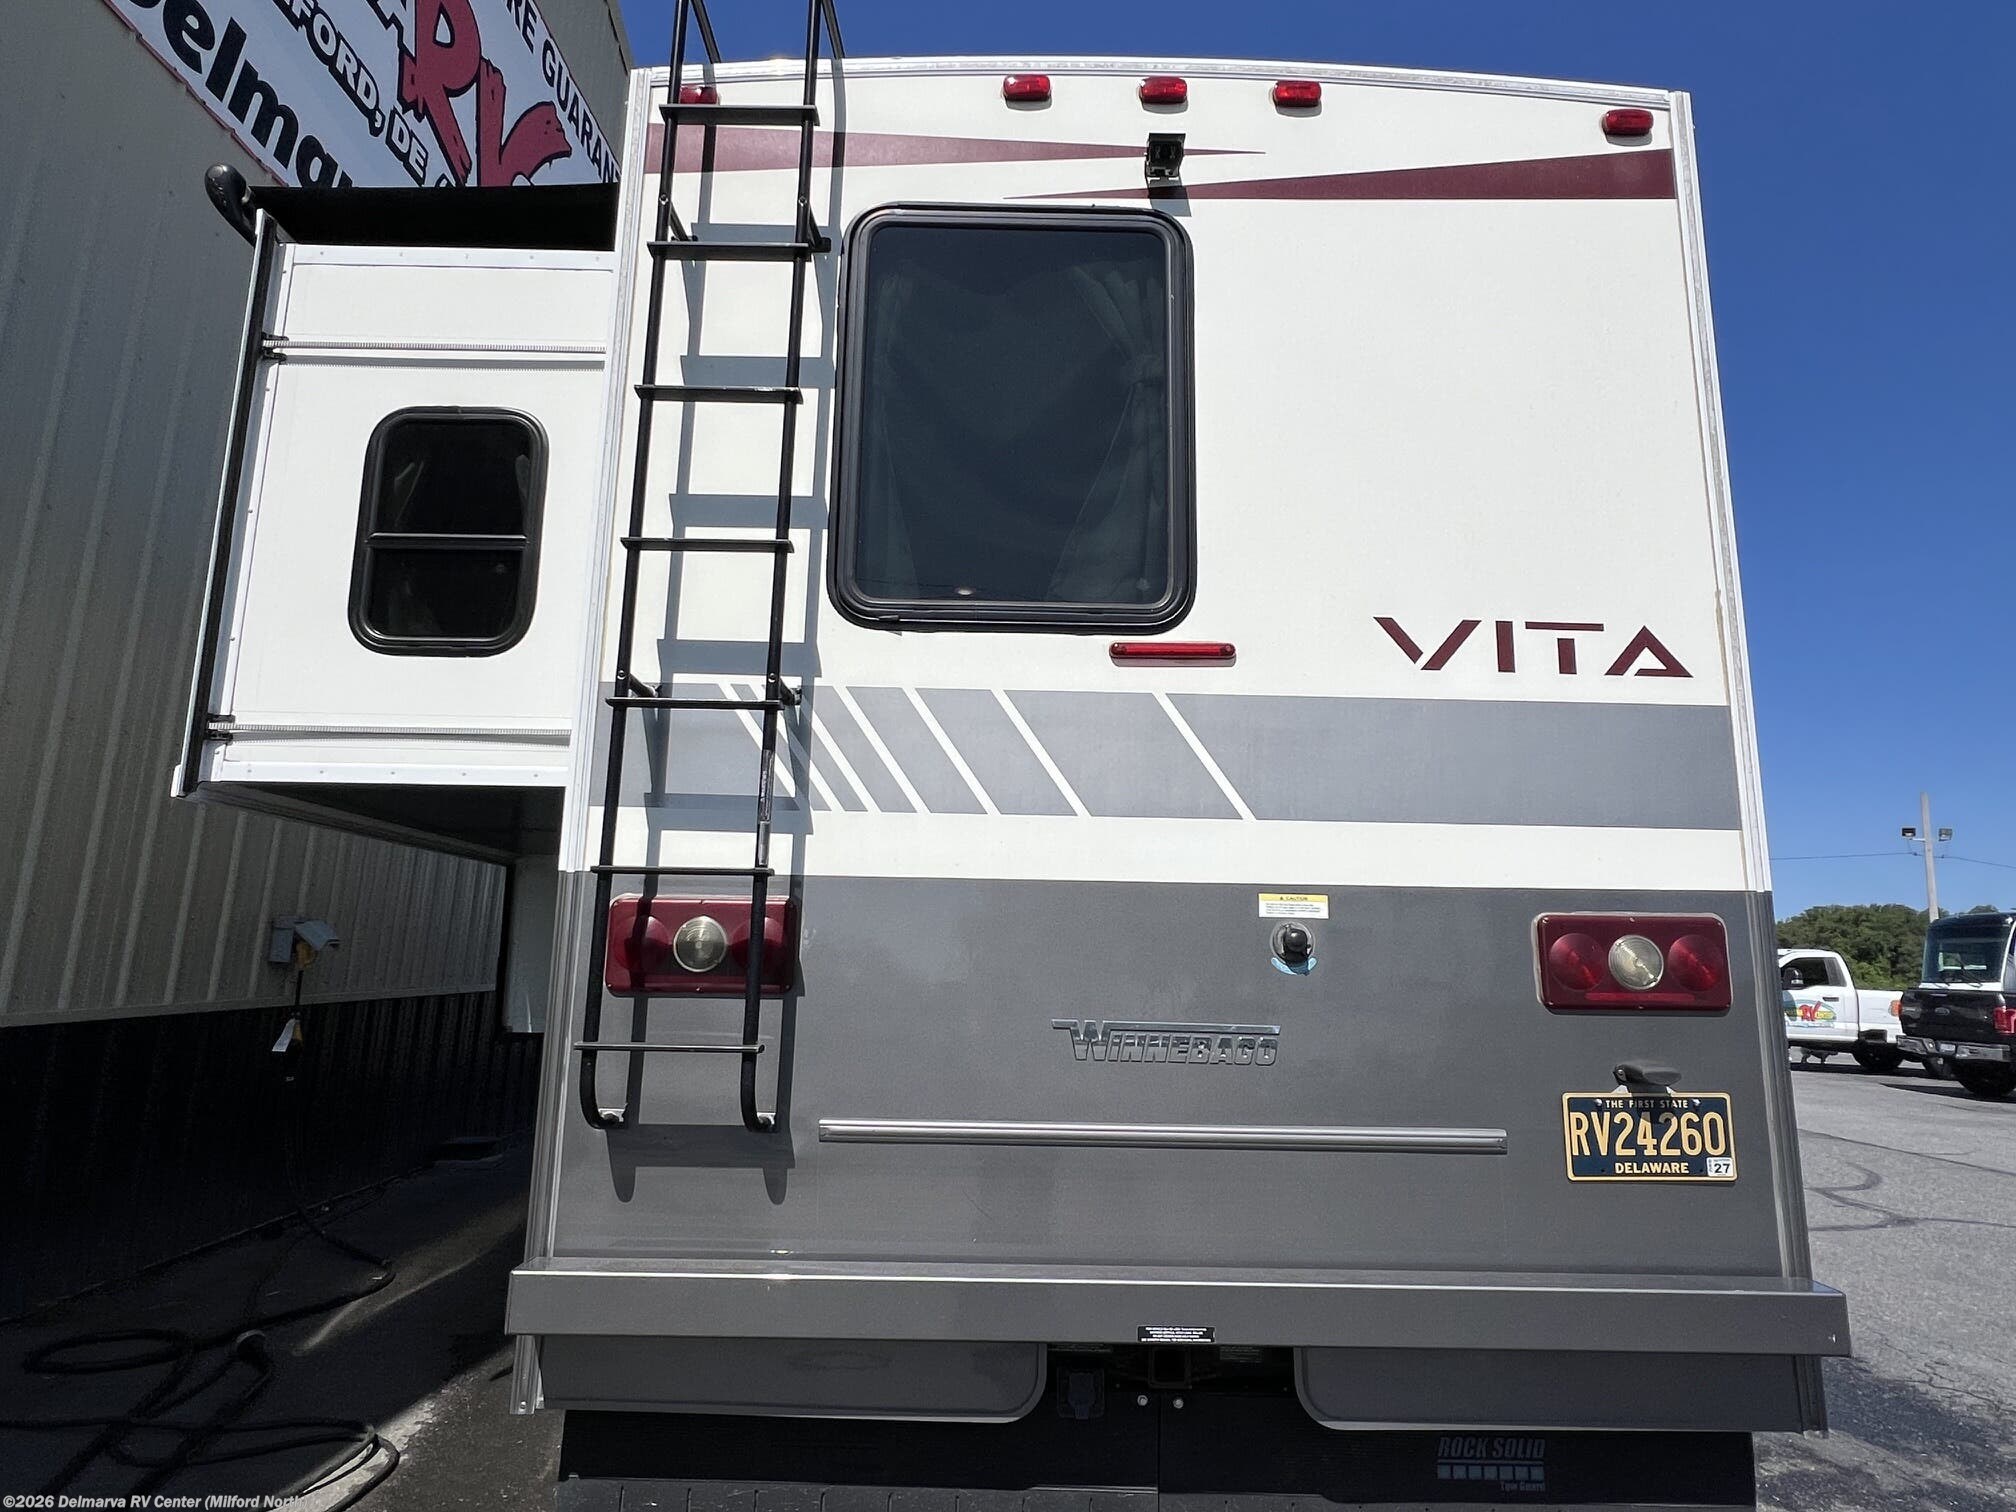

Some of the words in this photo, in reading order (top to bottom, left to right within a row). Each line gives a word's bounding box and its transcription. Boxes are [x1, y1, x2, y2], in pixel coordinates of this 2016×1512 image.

[542, 39, 620, 183] GUARAN
[388, 109, 428, 182] DE
[1373, 616, 1694, 678] VITA
[1606, 1100, 1623, 1109] THE
[1629, 1100, 1654, 1109] FIRST
[1660, 1100, 1688, 1109] STATE
[1569, 1111, 1726, 1156] RV24260
[1614, 1162, 1690, 1174] DELAWARE
[1714, 1163, 1731, 1173] 27
[1438, 1437, 1489, 1458] ROCK
[1492, 1437, 1545, 1458] SOLID
